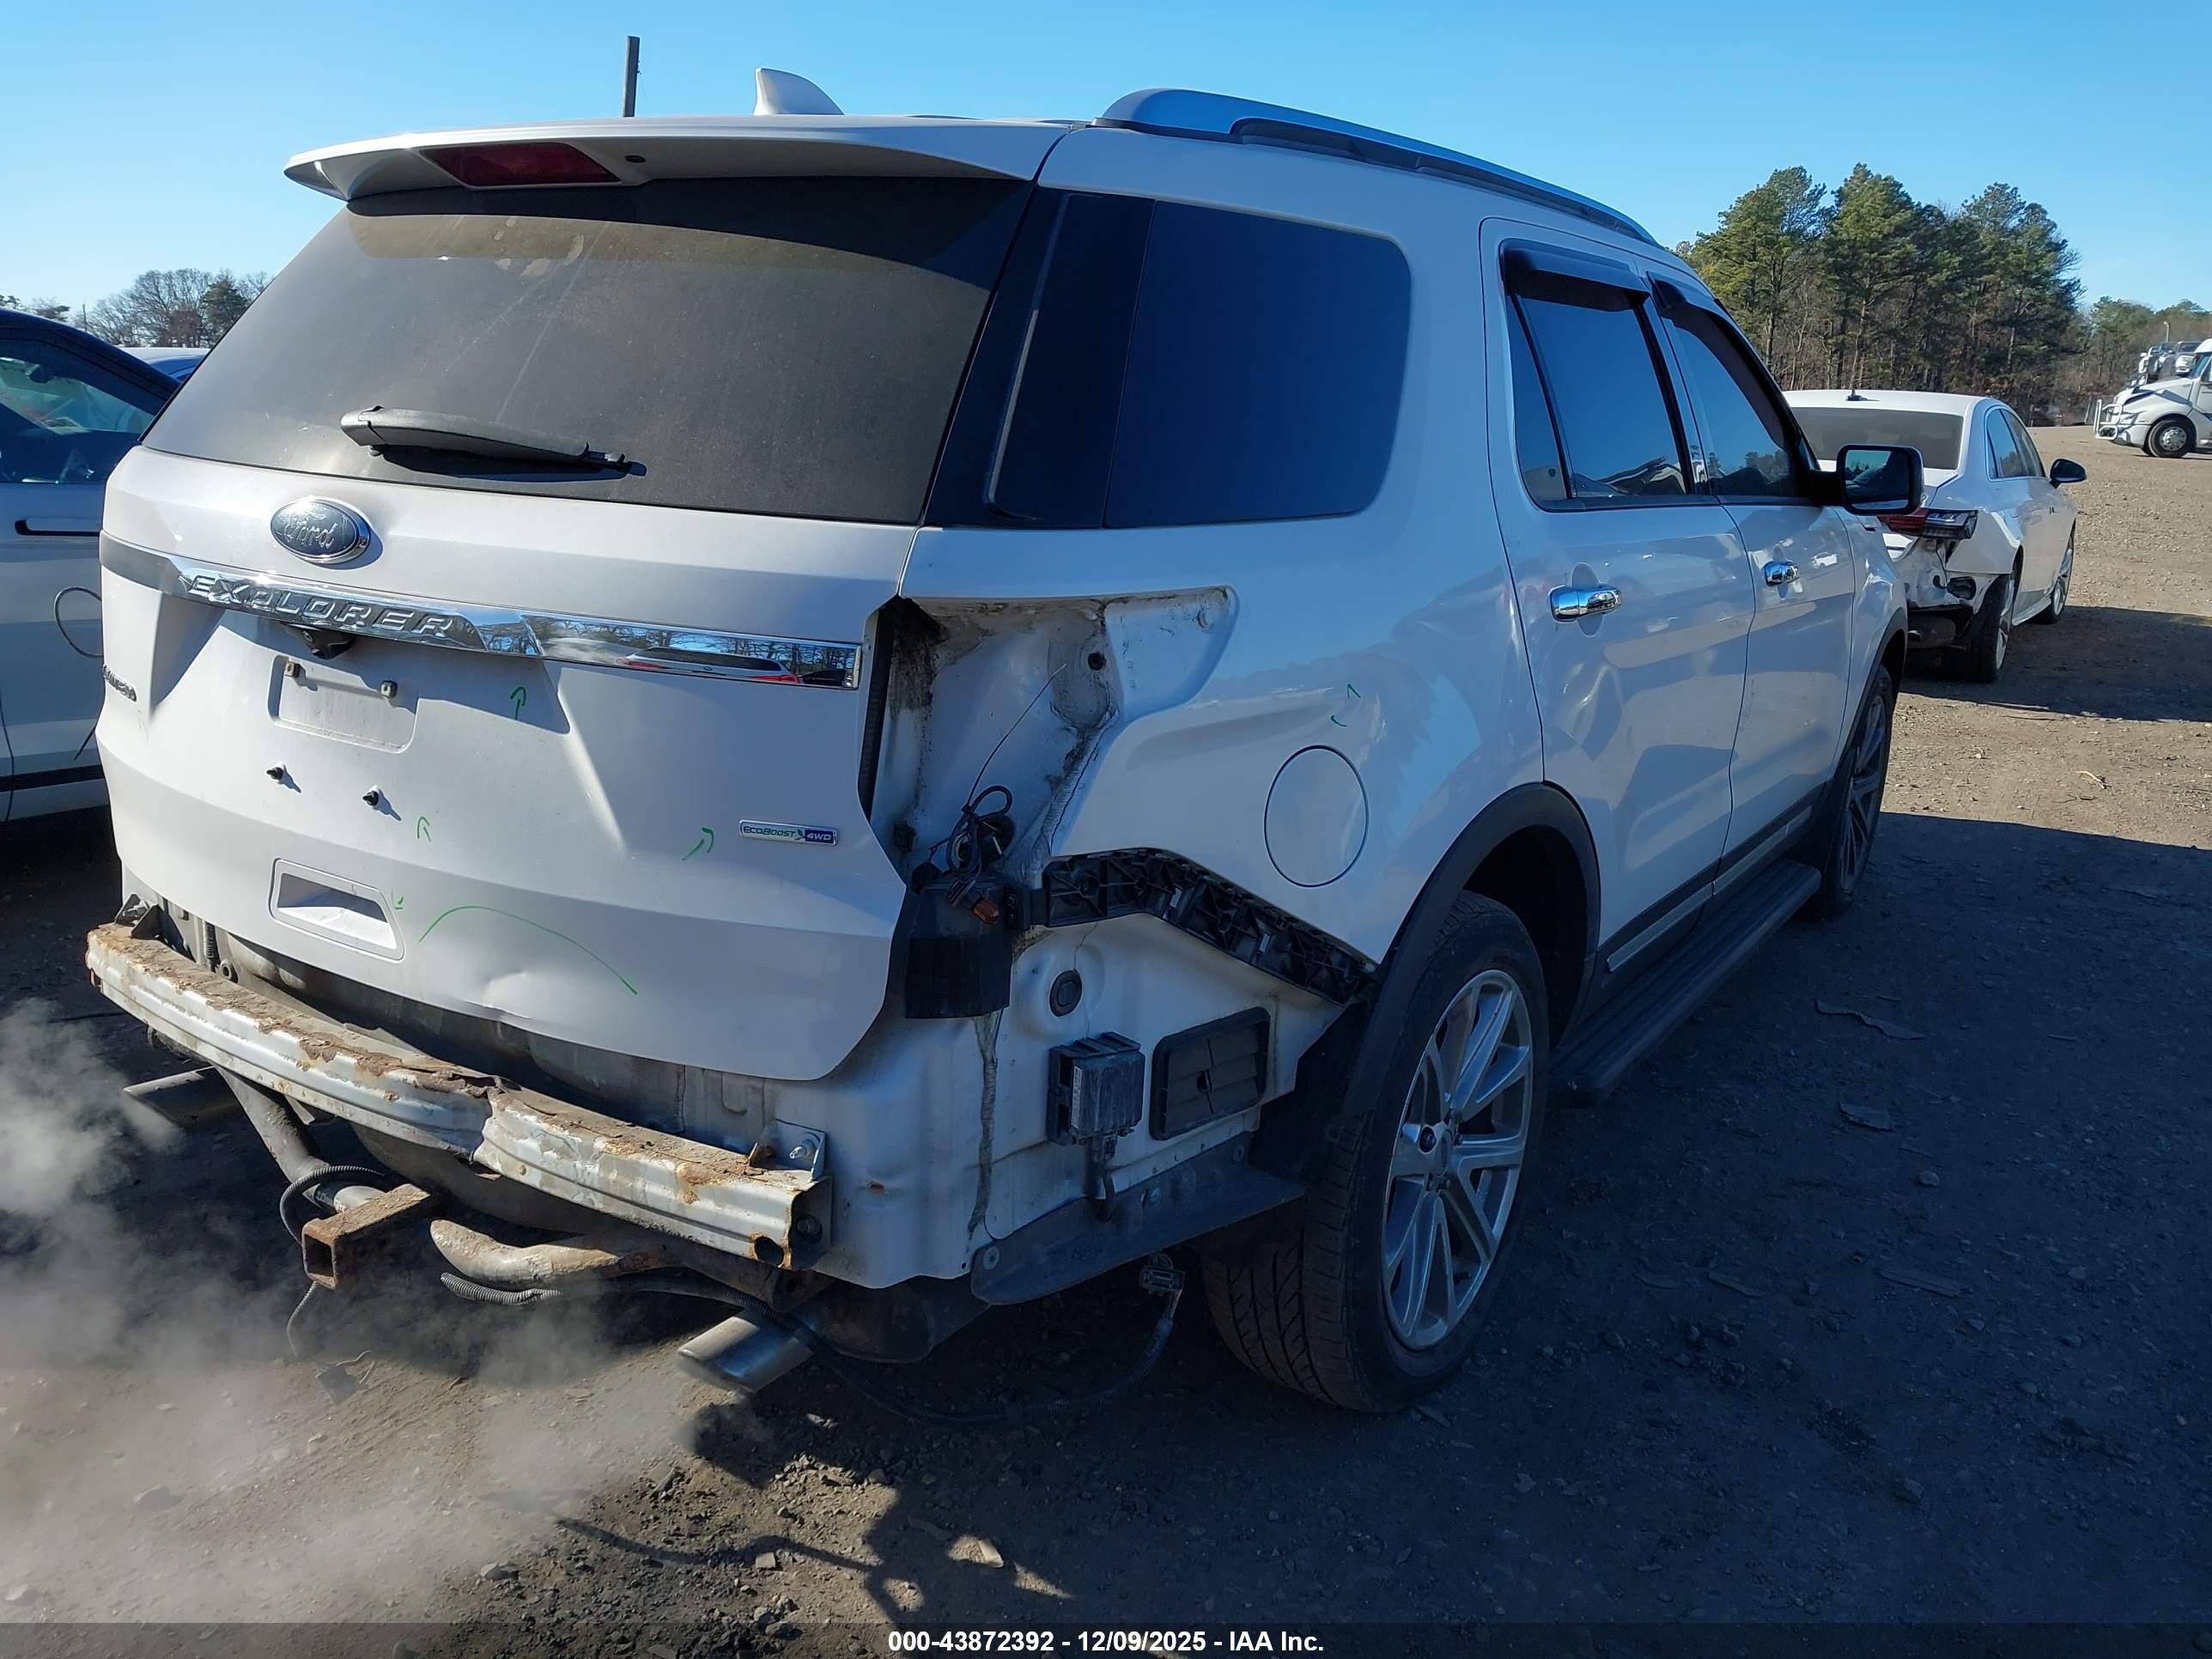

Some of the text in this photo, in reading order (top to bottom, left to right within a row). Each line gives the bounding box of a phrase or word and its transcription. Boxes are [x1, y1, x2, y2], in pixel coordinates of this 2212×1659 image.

[283, 511, 338, 550] Ford
[187, 573, 454, 638] EXPLORER
[806, 832, 833, 841] 4WD
